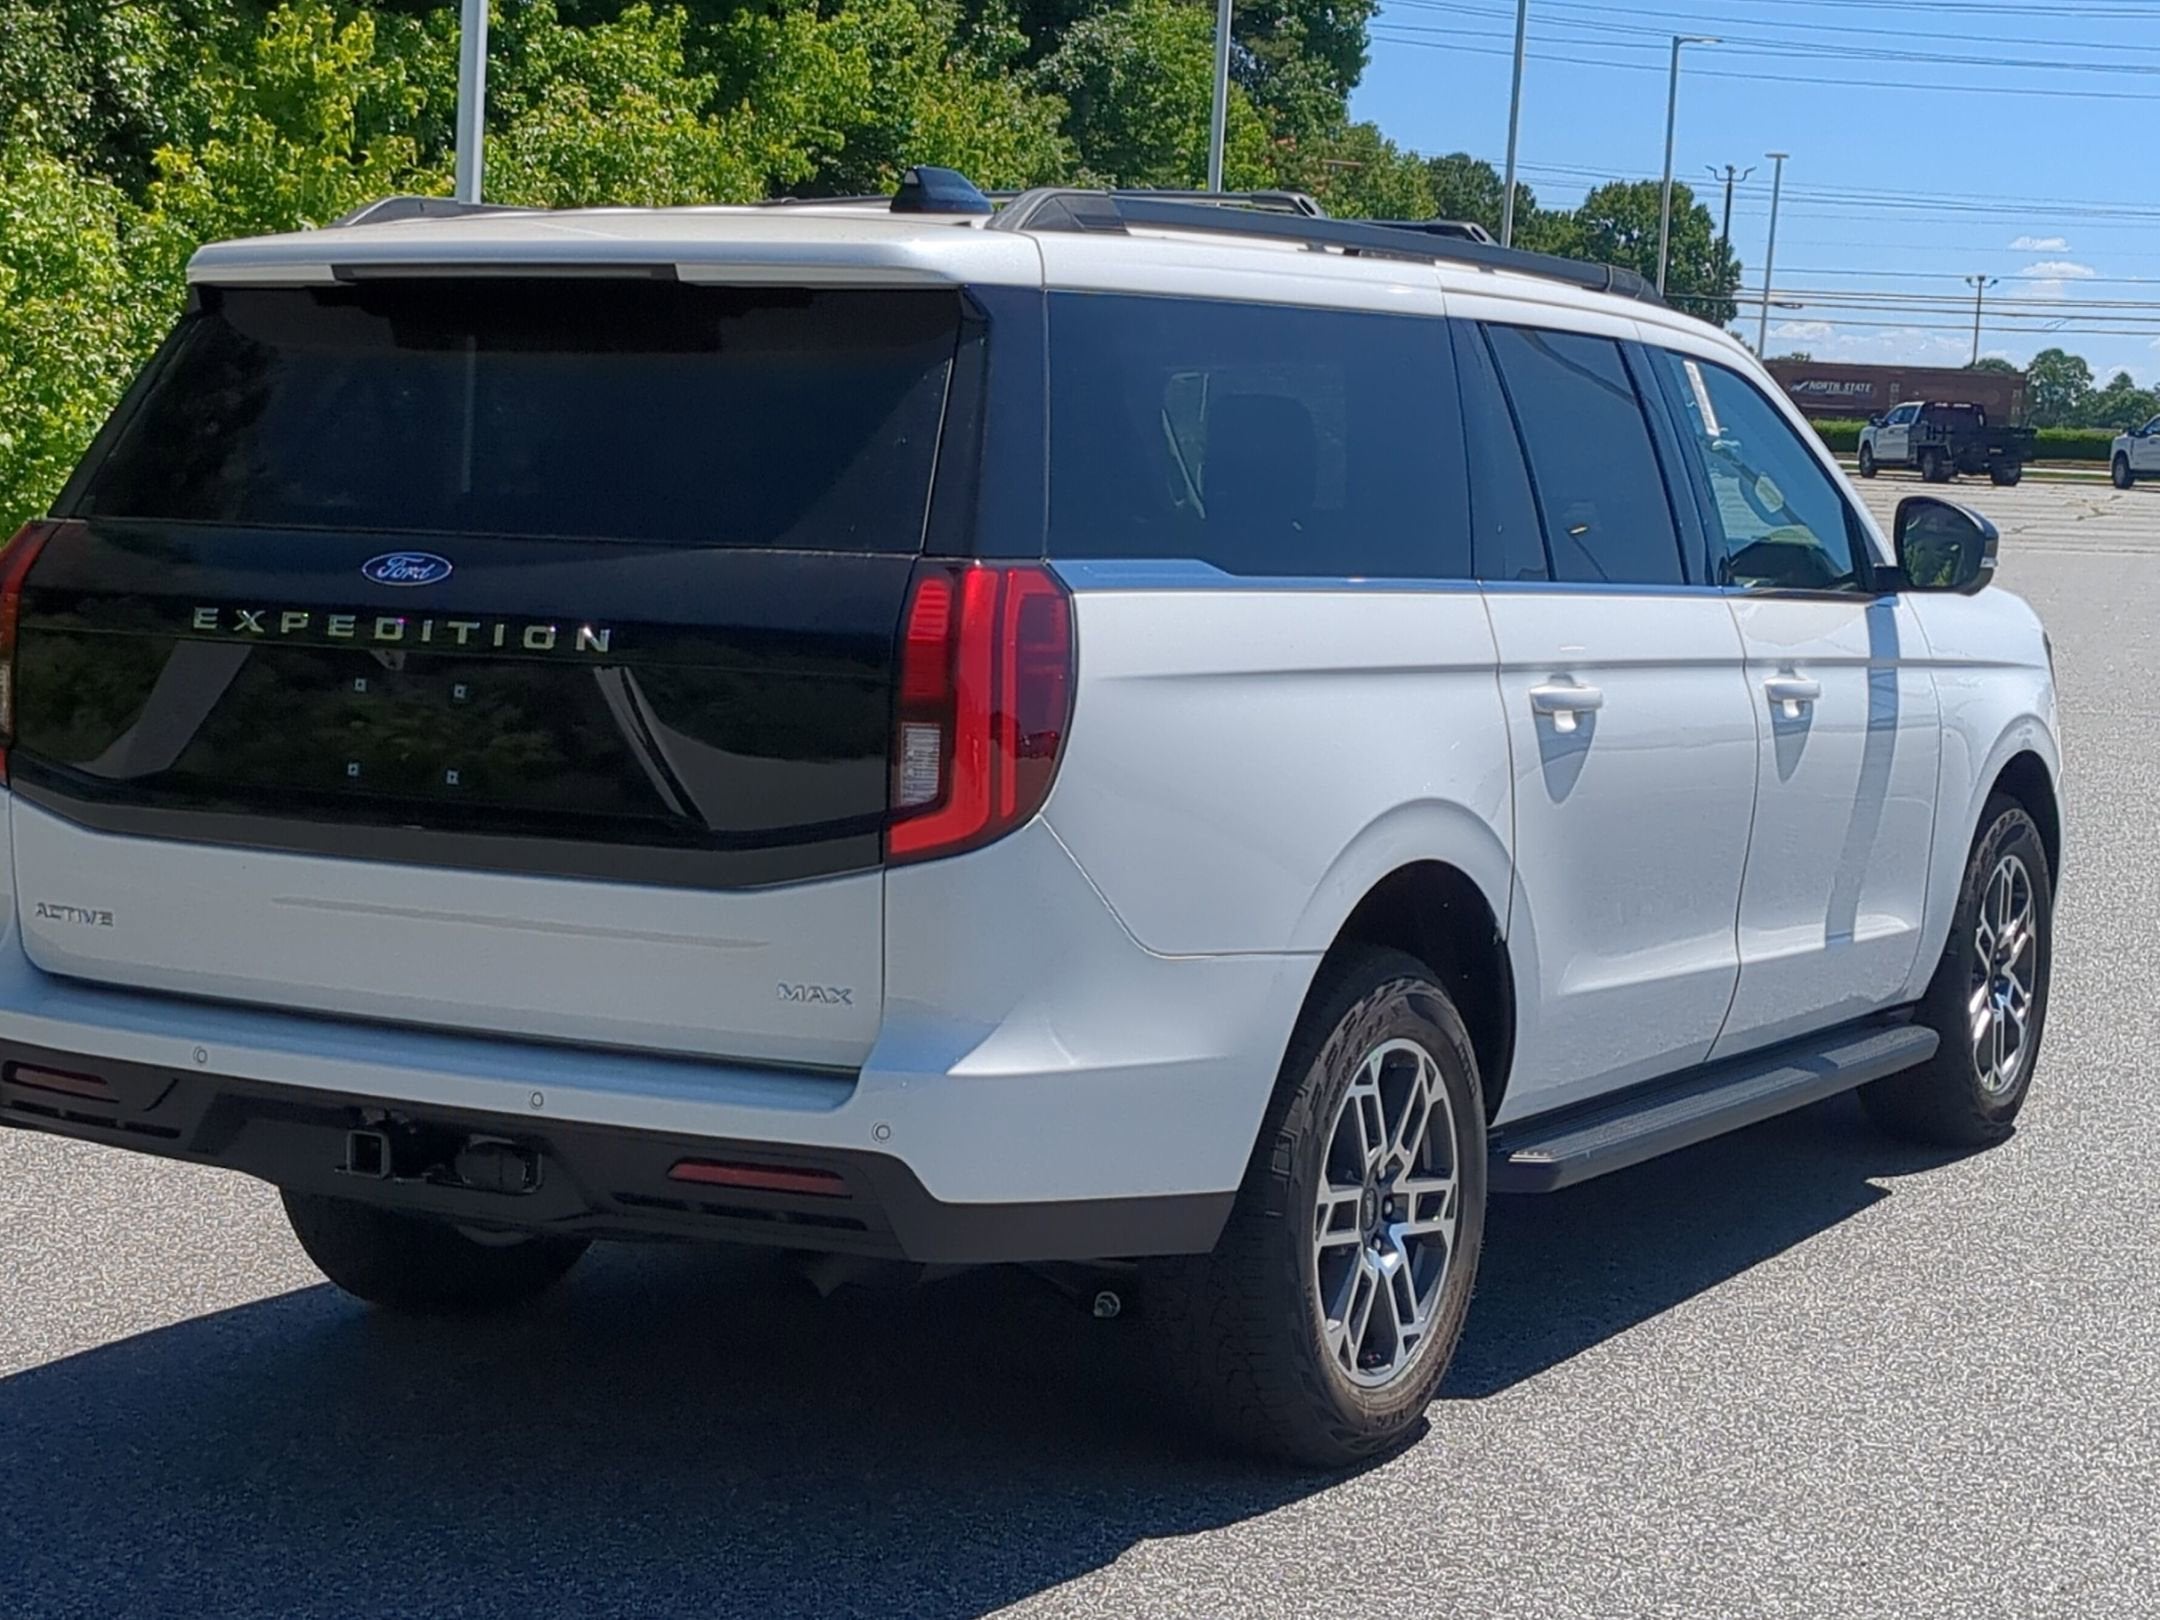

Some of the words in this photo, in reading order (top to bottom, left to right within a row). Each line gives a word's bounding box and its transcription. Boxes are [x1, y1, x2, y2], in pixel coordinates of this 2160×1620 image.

[1808, 381, 1841, 392] NORTH
[1844, 382, 1871, 393] STATE
[377, 555, 436, 580] Ford
[192, 606, 612, 653] EXPEDITION
[36, 902, 114, 928] ACTIVE
[777, 982, 853, 1005] MAX
